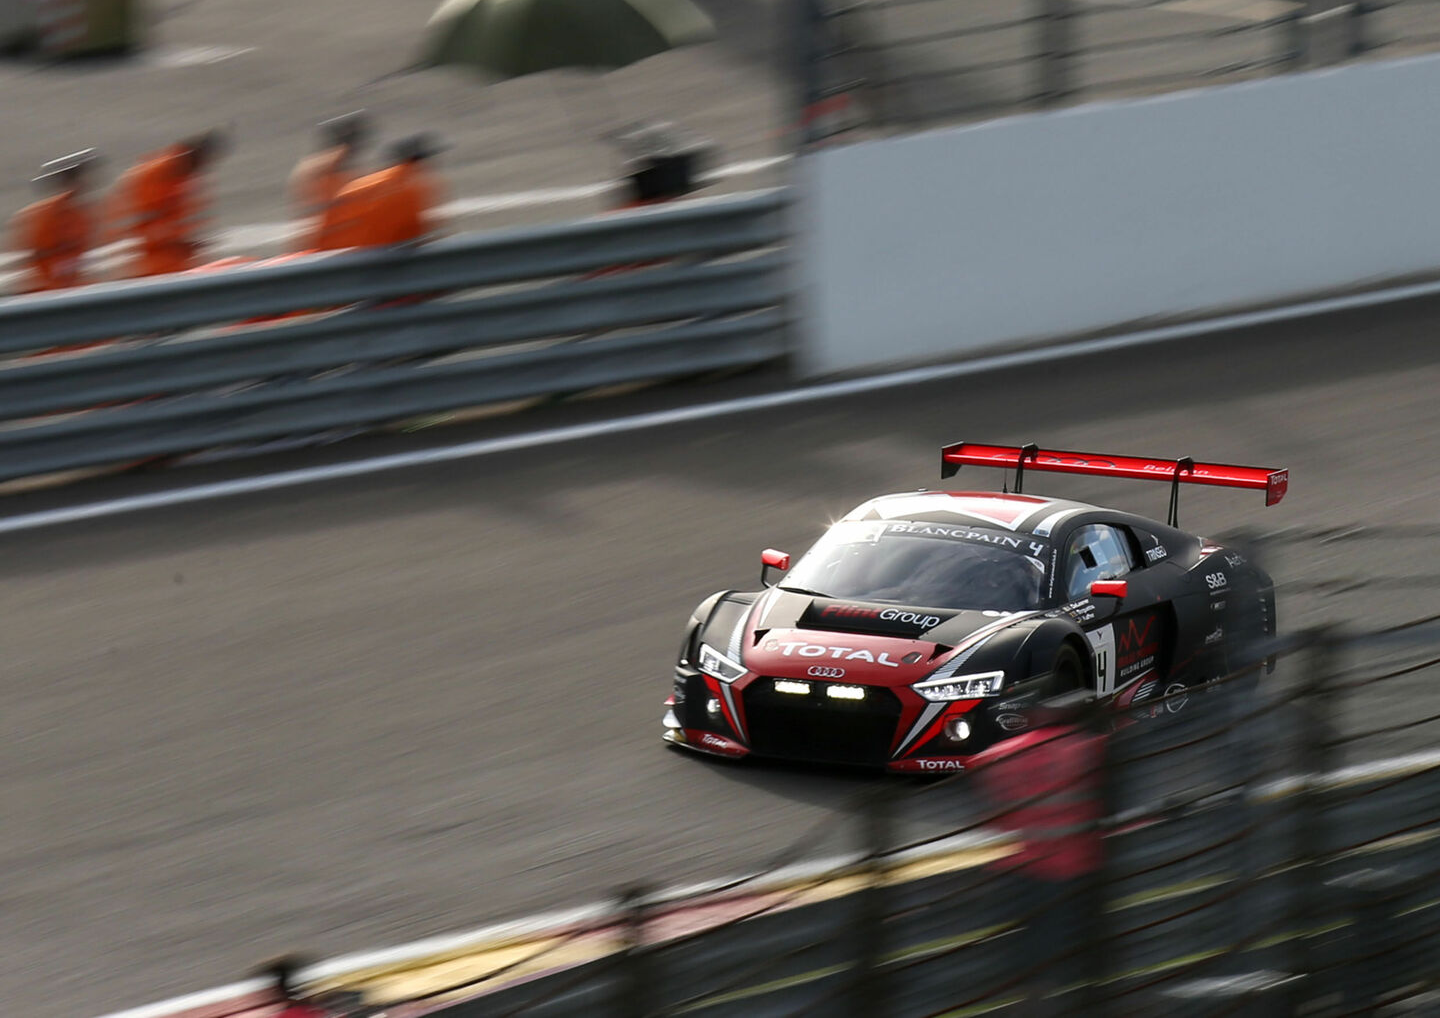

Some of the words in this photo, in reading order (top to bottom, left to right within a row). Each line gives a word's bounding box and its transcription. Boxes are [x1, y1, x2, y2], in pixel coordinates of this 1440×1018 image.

[889, 523, 1024, 549] BLANCPAIN
[1028, 541, 1044, 557] 4
[1205, 571, 1228, 589] S&B
[777, 640, 900, 668] TOTAL
[1097, 650, 1107, 693] 4
[916, 759, 966, 770] TOTAL
